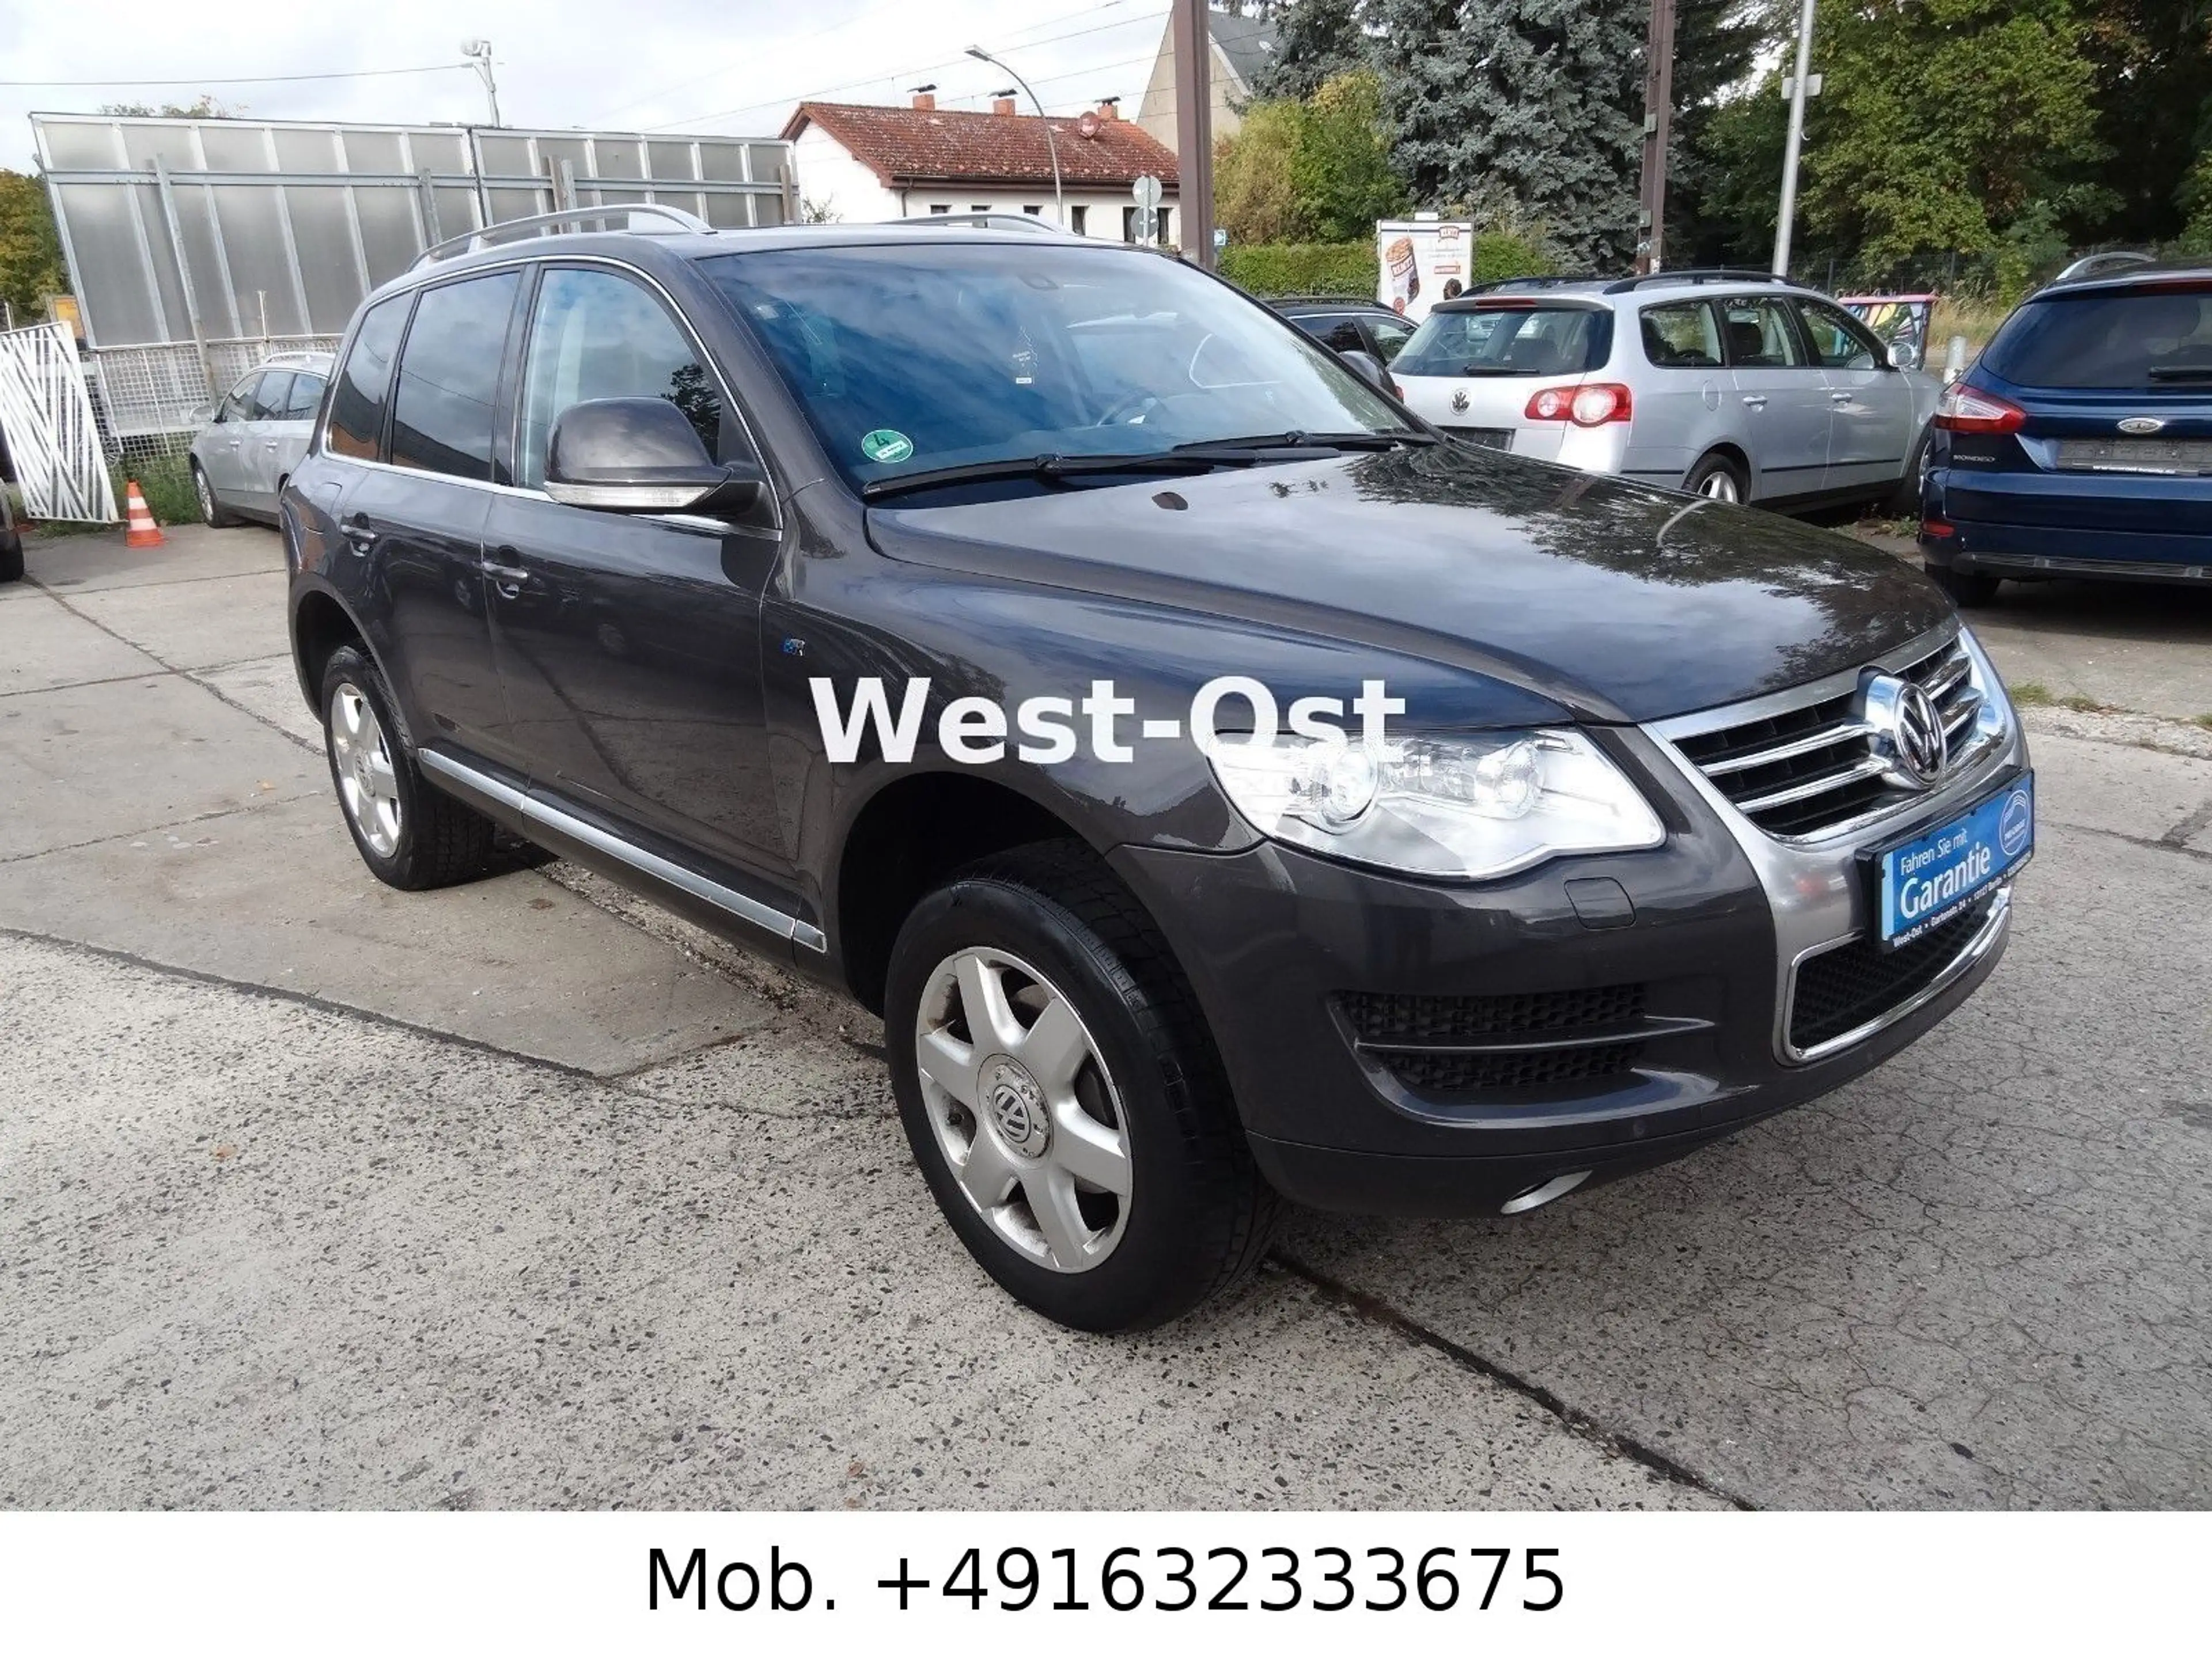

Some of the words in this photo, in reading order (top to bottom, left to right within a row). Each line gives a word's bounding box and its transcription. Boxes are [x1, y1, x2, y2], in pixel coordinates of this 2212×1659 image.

[873, 434, 891, 447] 4
[1901, 848, 1936, 876] Fahren
[1937, 838, 1952, 858] Sie
[1953, 828, 1968, 850] mit
[1900, 841, 1991, 919] Garantie
[1892, 924, 1923, 948] West-Ost
